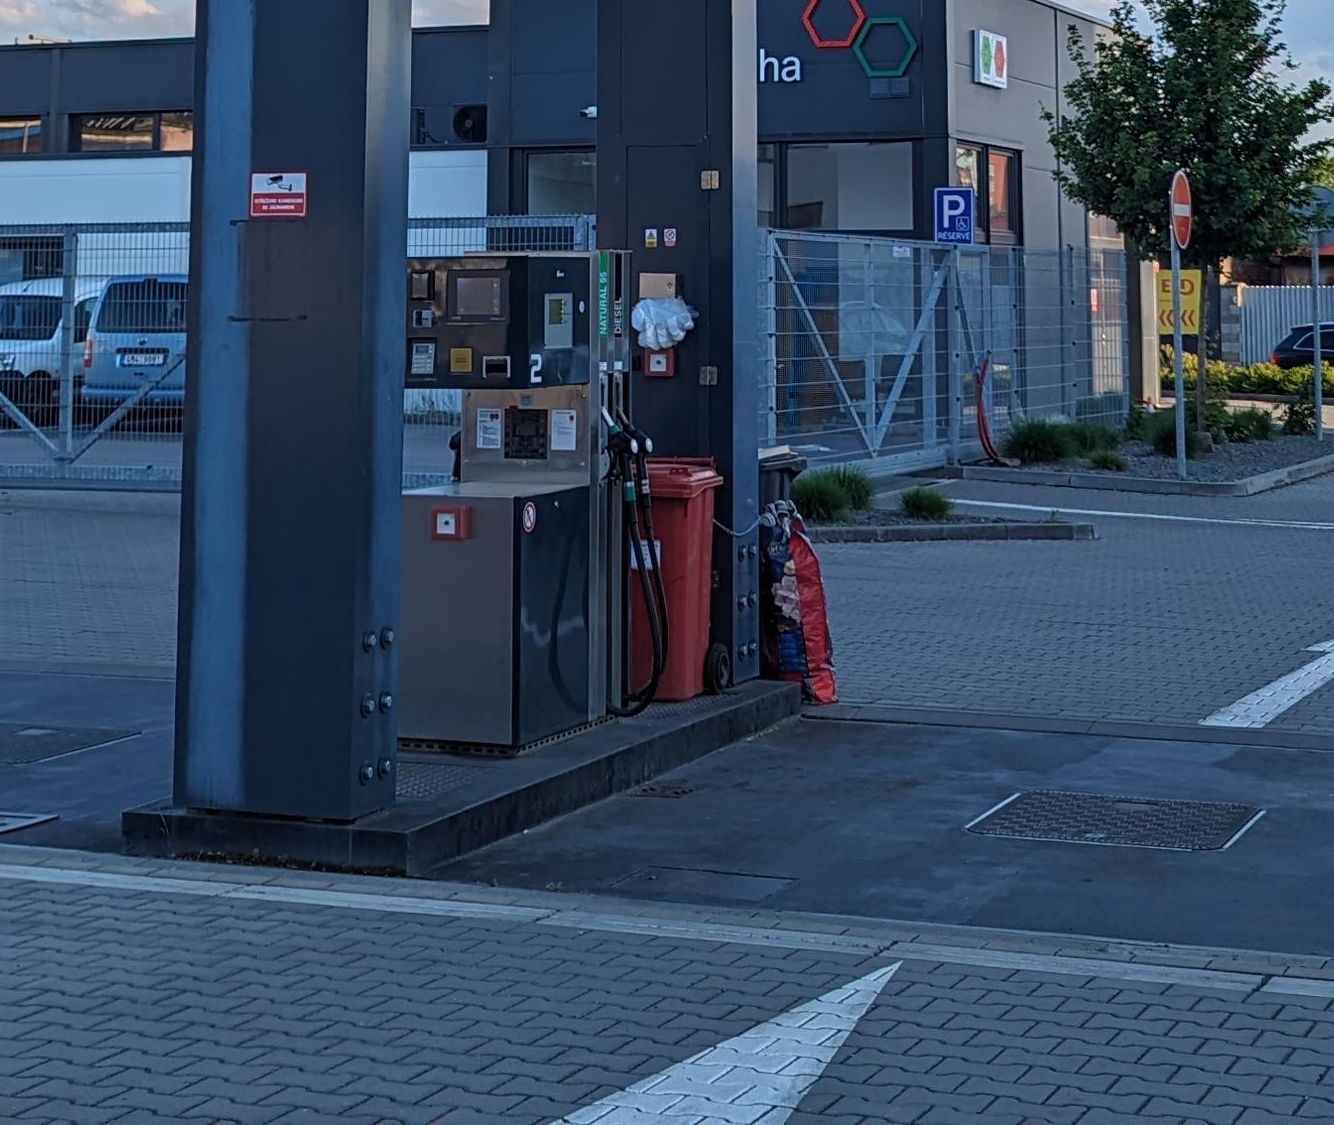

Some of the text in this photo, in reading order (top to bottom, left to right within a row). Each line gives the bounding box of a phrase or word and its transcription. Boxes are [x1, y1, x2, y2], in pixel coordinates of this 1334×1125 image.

[759, 48, 801, 82] ha
[943, 195, 965, 228] P
[599, 271, 607, 335] NATURAL 95
[614, 297, 622, 334] DIESEL
[530, 353, 543, 383] 2
